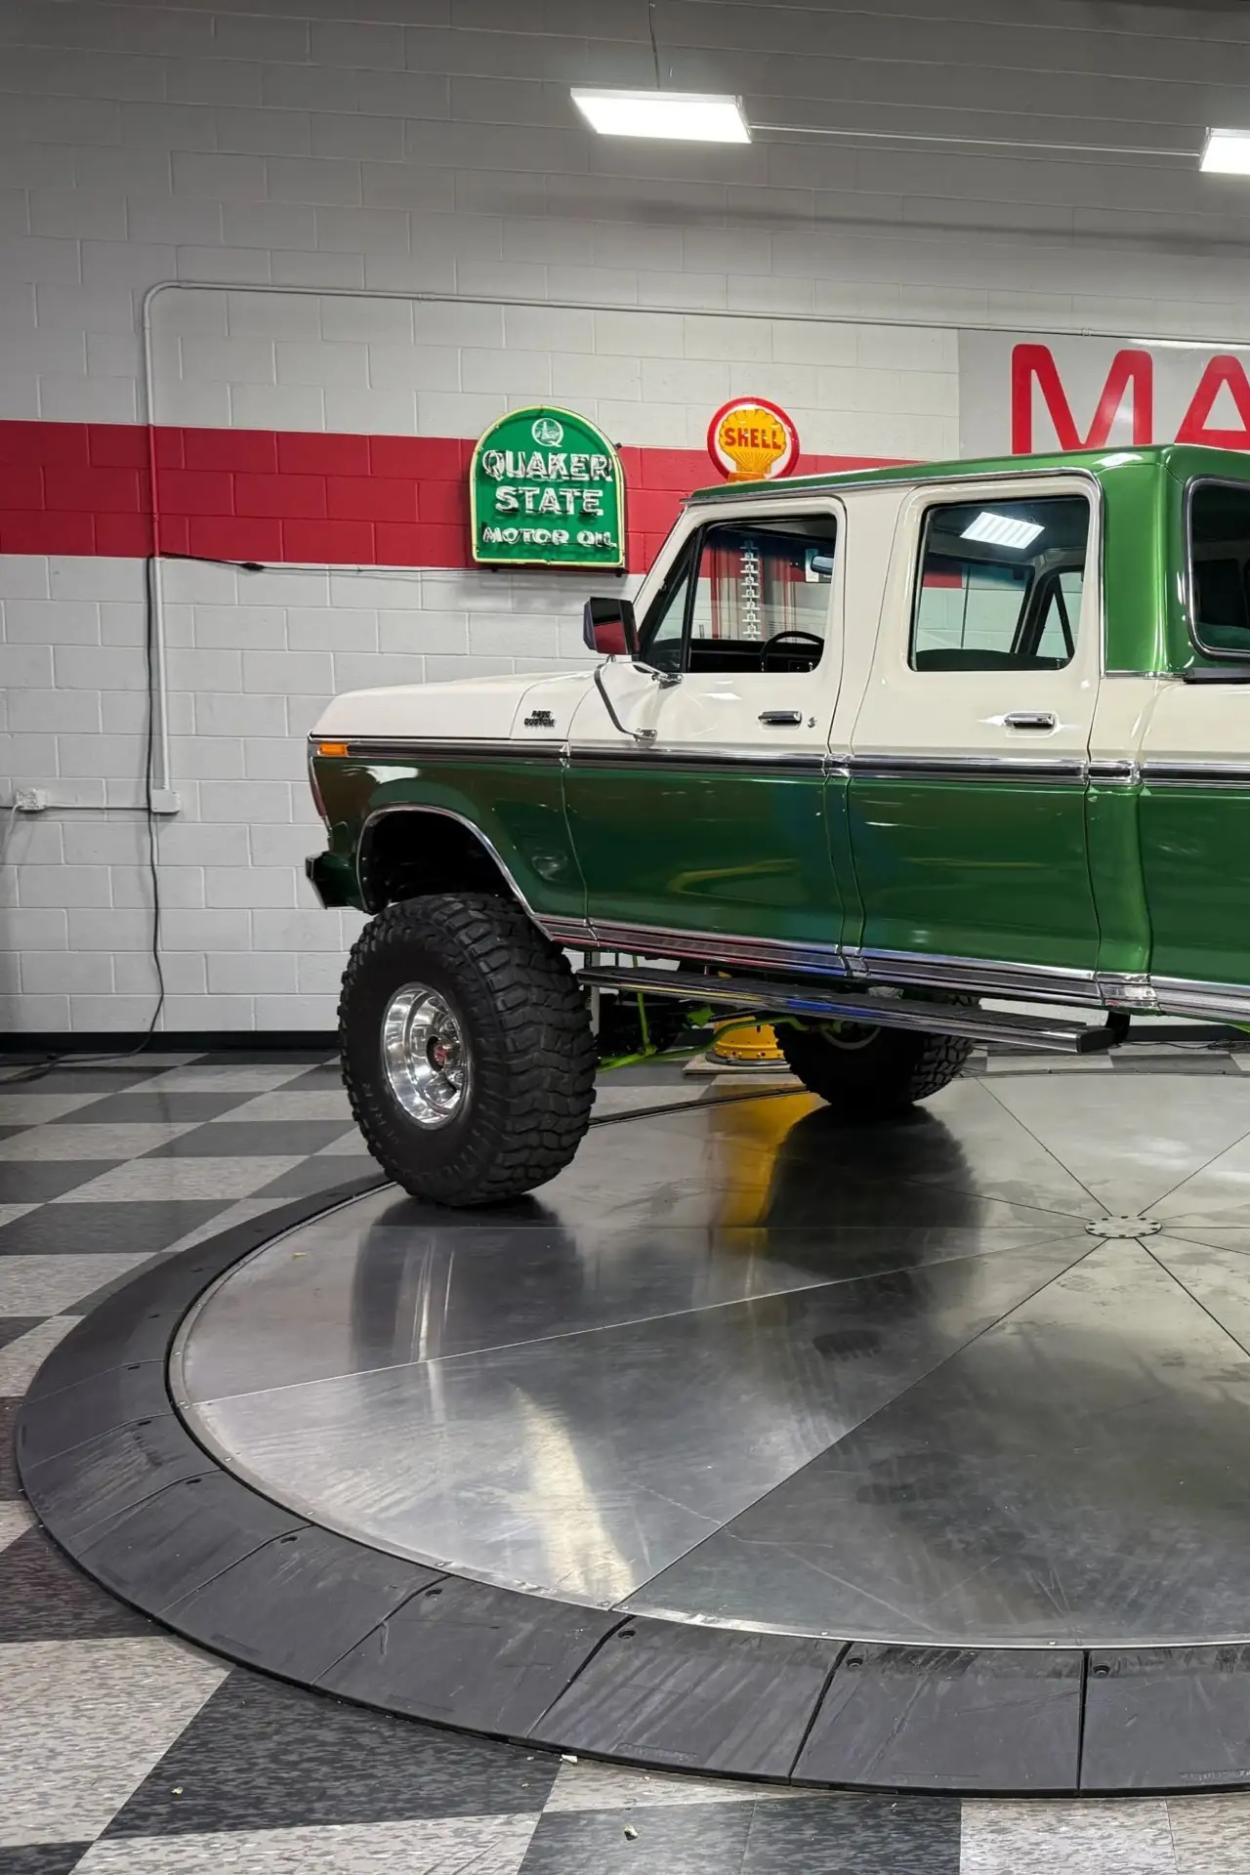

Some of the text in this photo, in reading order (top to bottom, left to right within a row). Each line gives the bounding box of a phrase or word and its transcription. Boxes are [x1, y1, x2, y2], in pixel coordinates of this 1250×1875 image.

[724, 427, 782, 450] SHELL
[482, 450, 613, 482] QUAKER
[495, 486, 604, 516] STATE
[482, 527, 617, 548] MOTOR OIL
